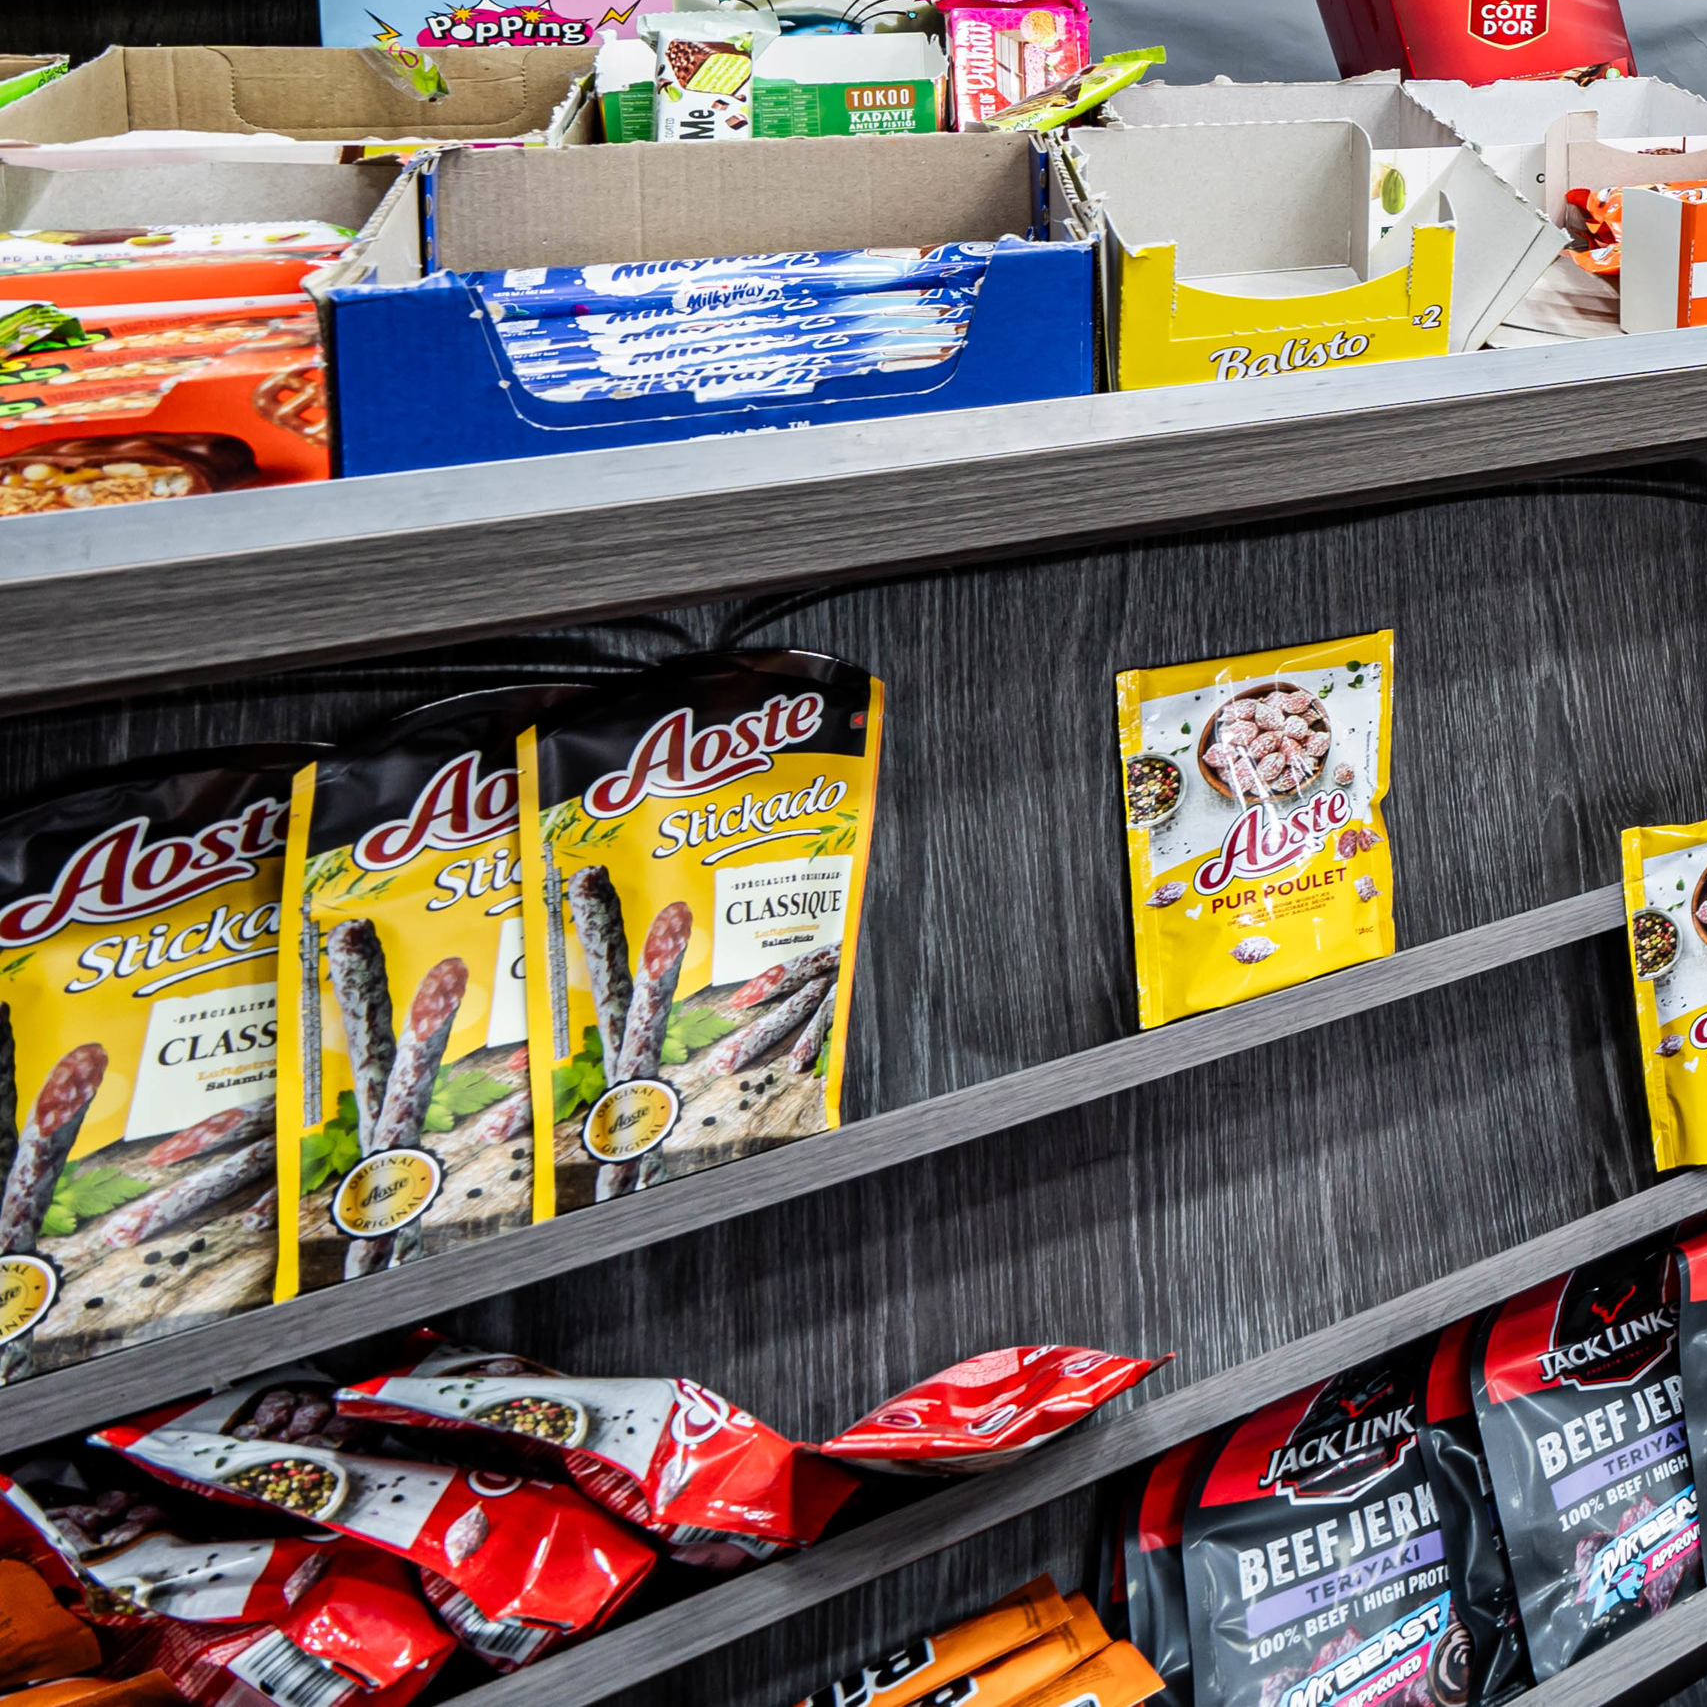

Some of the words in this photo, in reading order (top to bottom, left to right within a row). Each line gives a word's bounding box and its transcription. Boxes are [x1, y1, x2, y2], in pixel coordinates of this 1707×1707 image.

[1481, 0, 1538, 20] CÔTE
[1483, 20, 1534, 36] D'OR
[849, 110, 914, 124] KADAYIF
[850, 88, 910, 107] TOKOO
[979, 93, 996, 105] OF
[1208, 330, 1370, 382] Balisto
[585, 691, 824, 818] Aoste
[651, 774, 849, 860] Stickado
[1193, 788, 1353, 896] Aoste
[734, 874, 797, 890] SPÉCIALITÉ
[1211, 889, 1257, 914] PUR
[1263, 866, 1348, 899] POULET
[726, 888, 842, 926] CLASSIQUE
[158, 1021, 278, 1067] CLASS
[596, 1084, 656, 1119] ORIGINAL
[608, 1104, 650, 1135] Aoste
[600, 1122, 663, 1155] ORIGINAL
[345, 1153, 424, 1193] ORIGINAL
[362, 1176, 411, 1207] Aoste
[353, 1191, 432, 1232] ORIGINAL
[1537, 1335, 1604, 1383] JACK
[1536, 1405, 1626, 1480] BEEF
[1633, 1375, 1684, 1435] JER
[1257, 1431, 1343, 1490] JACK
[1558, 1505, 1603, 1534] 100%
[1604, 1480, 1644, 1510] BEEF
[1650, 1453, 1689, 1484] HIGH
[1238, 1522, 1343, 1601] BEEF
[1304, 1543, 1425, 1605] TERIYAKI
[1248, 1626, 1302, 1665] 100%
[1304, 1604, 1351, 1642] BEEF
[1361, 1580, 1407, 1617] HIGH
[1331, 1648, 1431, 1707] APPROVED
